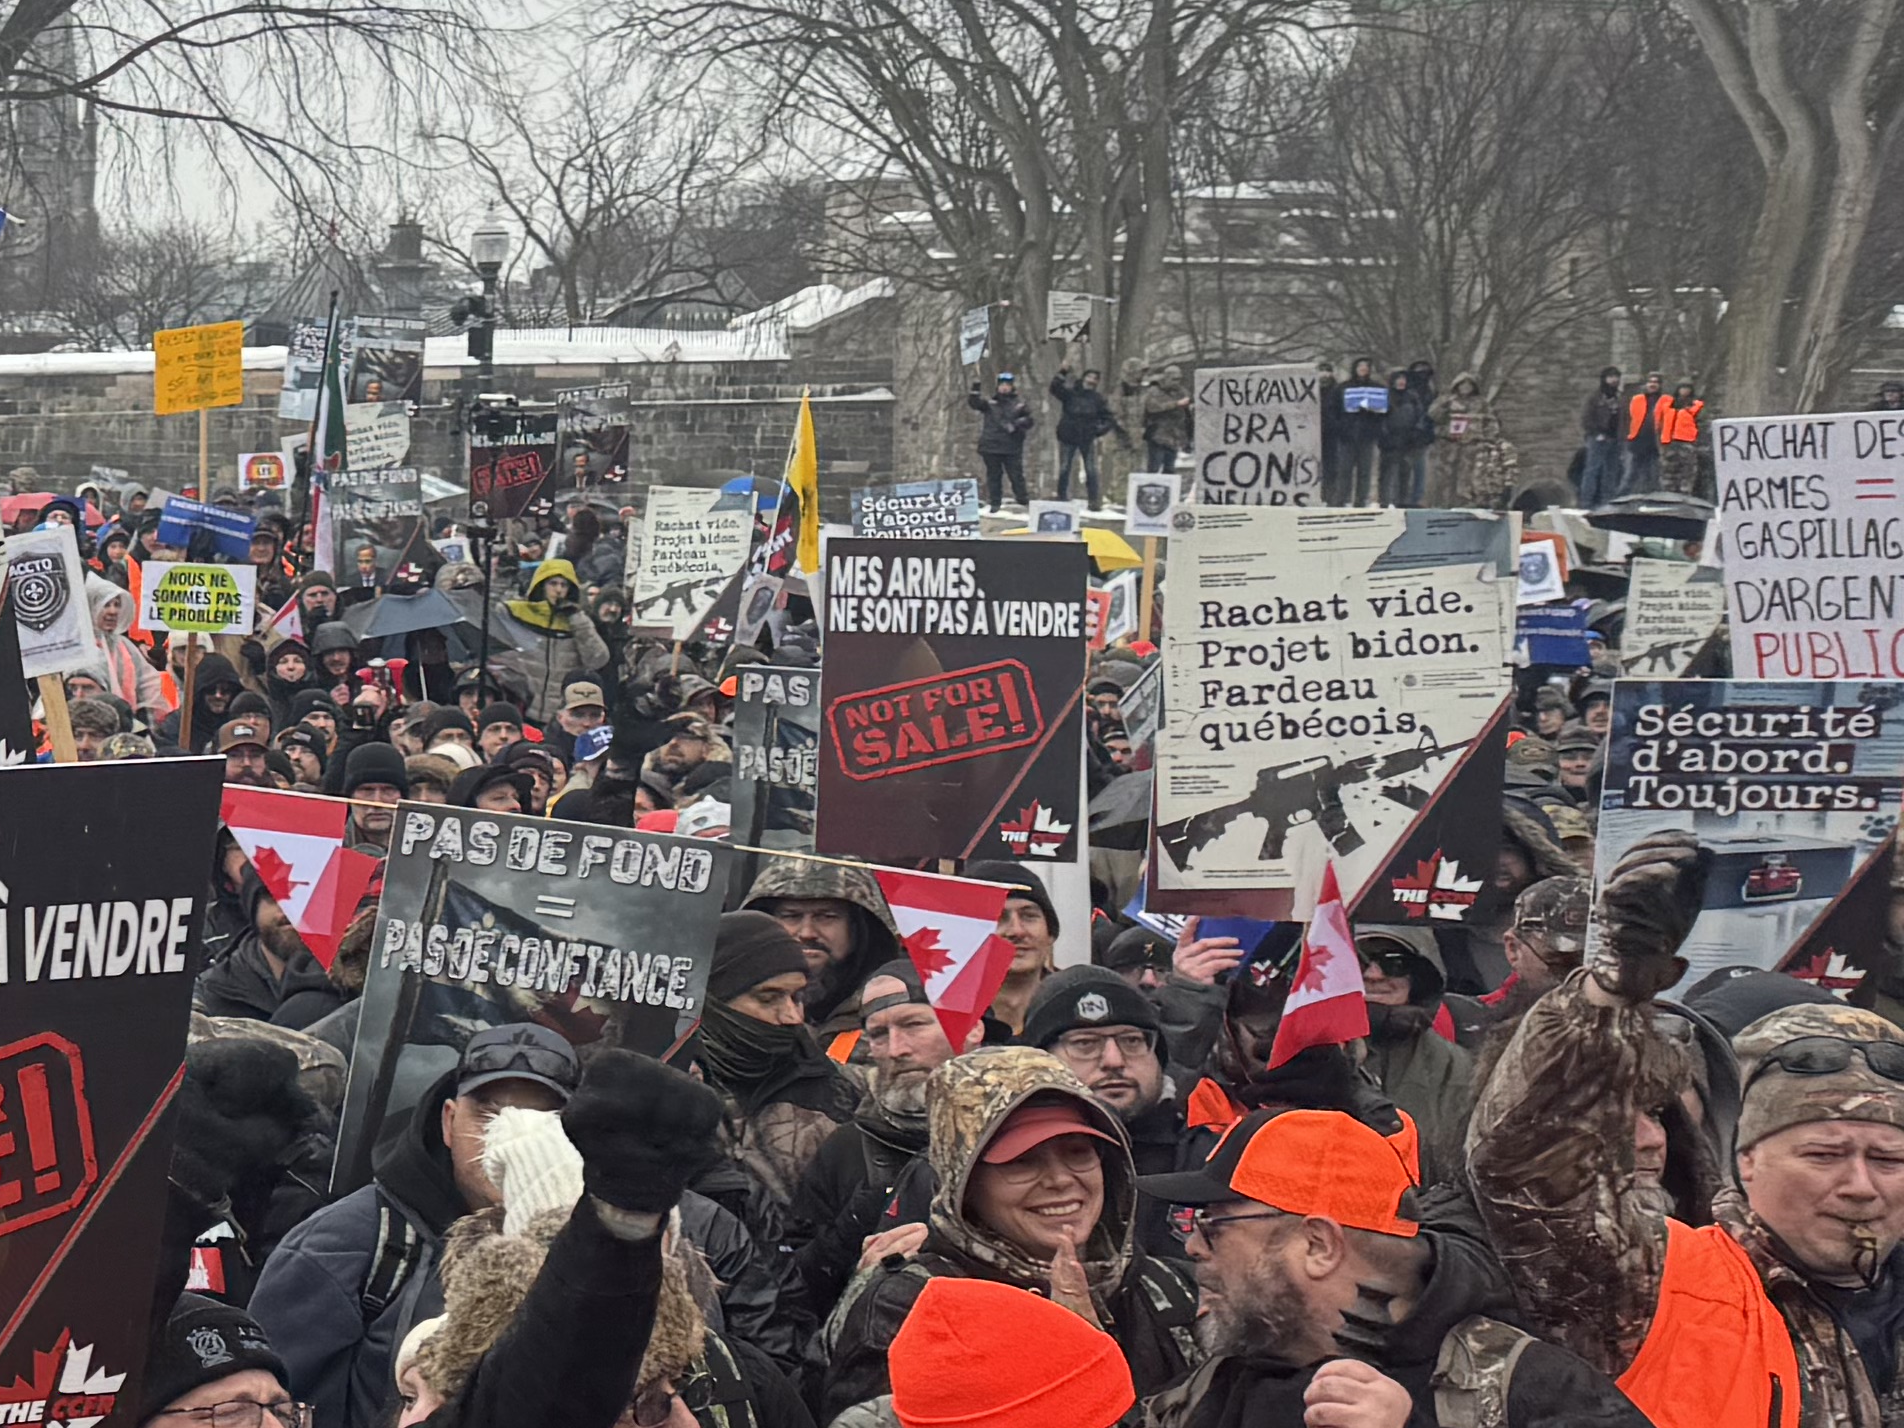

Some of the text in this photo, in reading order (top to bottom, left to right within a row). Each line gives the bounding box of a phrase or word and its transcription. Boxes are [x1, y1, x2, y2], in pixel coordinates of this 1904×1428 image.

[1720, 420, 1836, 462] RACHAT
[861, 489, 963, 513] Sécurité
[1721, 474, 1832, 513] ARMES
[654, 518, 740, 532] Rachat vide.
[862, 507, 955, 528] d'abord.
[651, 548, 707, 561] Fardeau
[653, 534, 740, 548] Projet bidon.
[1734, 516, 1903, 561] GASPILLAG
[168, 571, 228, 588] NOUS NE
[831, 555, 977, 599] MES ARMES
[149, 606, 165, 621] LE
[152, 589, 242, 606] SOMMES PAS
[829, 588, 1081, 639] NE SONT PAS À VENDRE
[1199, 586, 1475, 630] Rachat vide.
[1733, 575, 1904, 624] D'ARGEN
[1198, 627, 1480, 672] Projet bidon.
[742, 672, 810, 707] PAS
[845, 676, 994, 730] NOT FOR
[1199, 675, 1379, 709] Fardeau
[1635, 704, 1876, 739] Sécurité
[1632, 739, 1850, 775] d'abord.
[1629, 773, 1877, 817] Toujours.
[401, 811, 714, 894] PAS DE FOND
[1392, 889, 1429, 903] THE
[24, 897, 193, 983] VENDRE
[380, 918, 695, 1012] PAS CONFIANCE.
